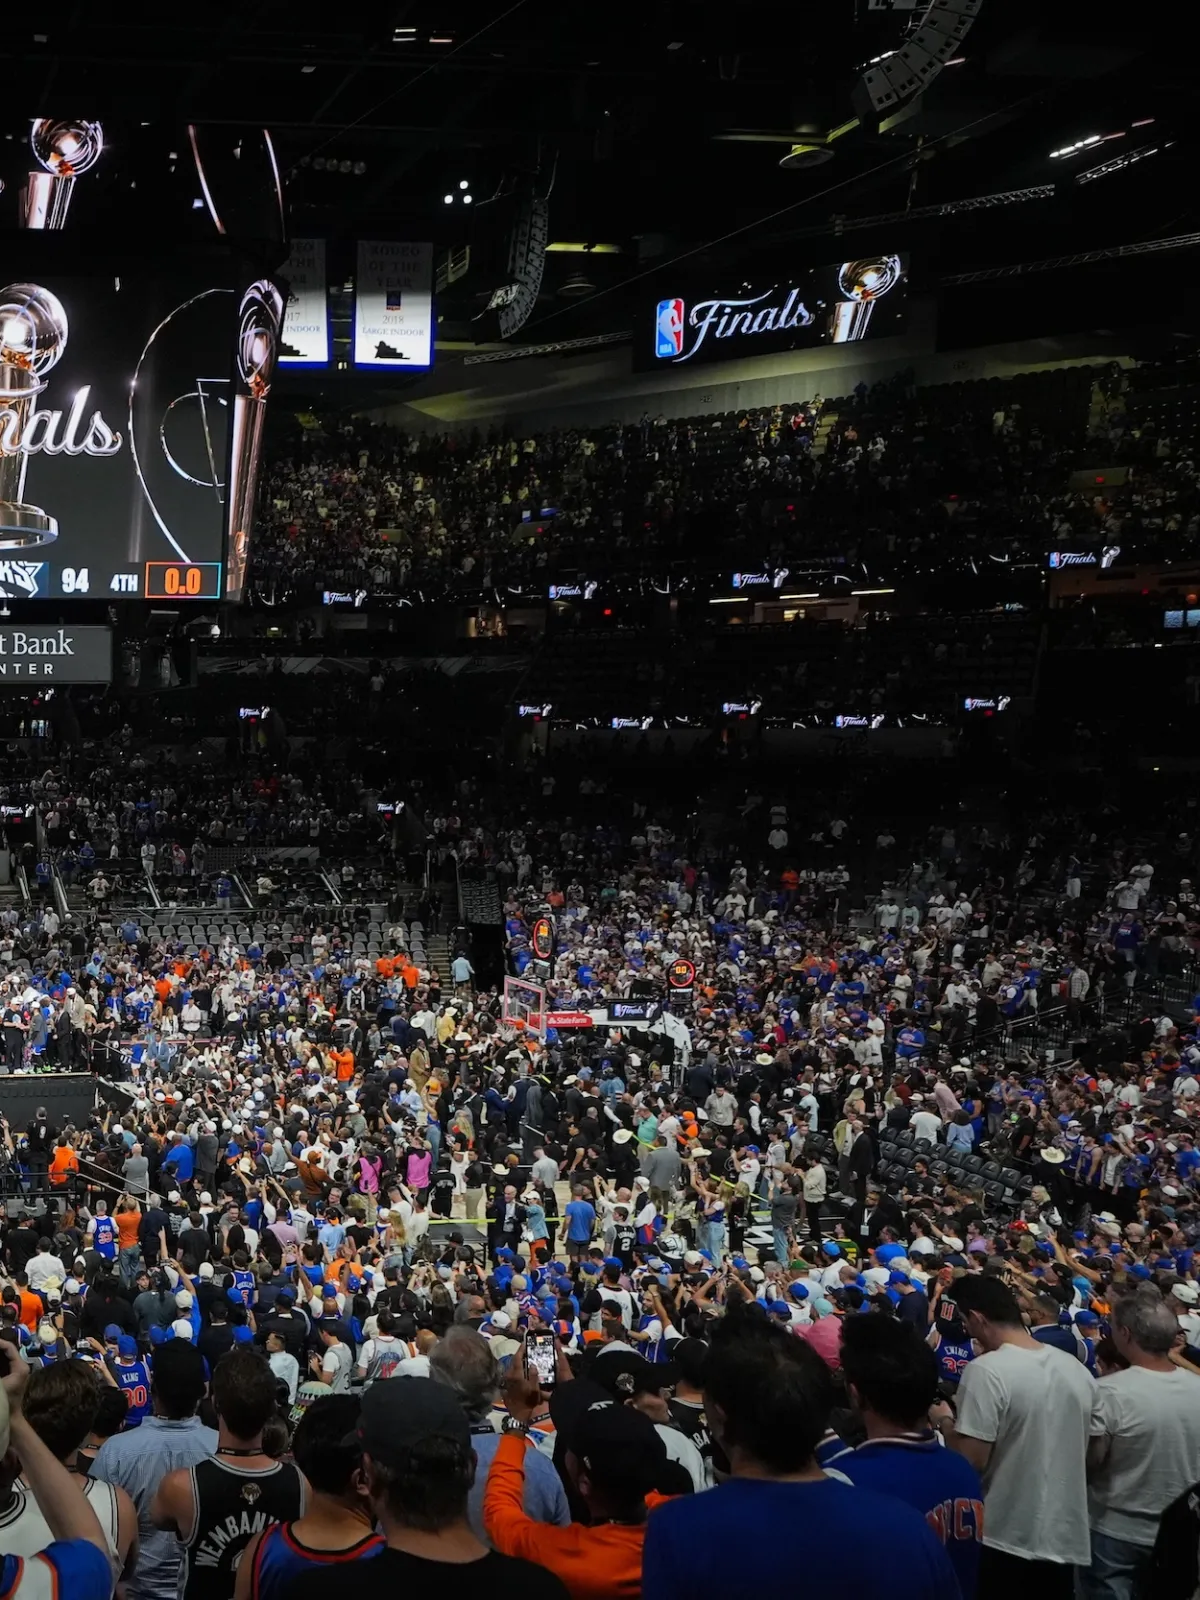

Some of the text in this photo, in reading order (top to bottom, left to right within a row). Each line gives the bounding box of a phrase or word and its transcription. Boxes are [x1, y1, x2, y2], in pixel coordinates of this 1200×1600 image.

[382, 315, 404, 325] 2018
[672, 287, 815, 363] Finals
[391, 327, 425, 336] INDOOR
[1056, 552, 1097, 569] Finals
[61, 566, 90, 593] 94
[110, 573, 139, 592] 4TH
[164, 567, 201, 595] 0.0
[740, 573, 770, 588] Finals
[328, 592, 353, 604] Finals
[553, 585, 581, 599] Finals
[12, 629, 74, 656] Bank
[842, 715, 869, 727] Finals
[619, 1004, 644, 1018] Finals
[98, 1232, 113, 1244] 33
[620, 1238, 632, 1251] 2
[940, 1301, 956, 1321] 11
[944, 1346, 969, 1359] EWING
[121, 1371, 140, 1384] KING
